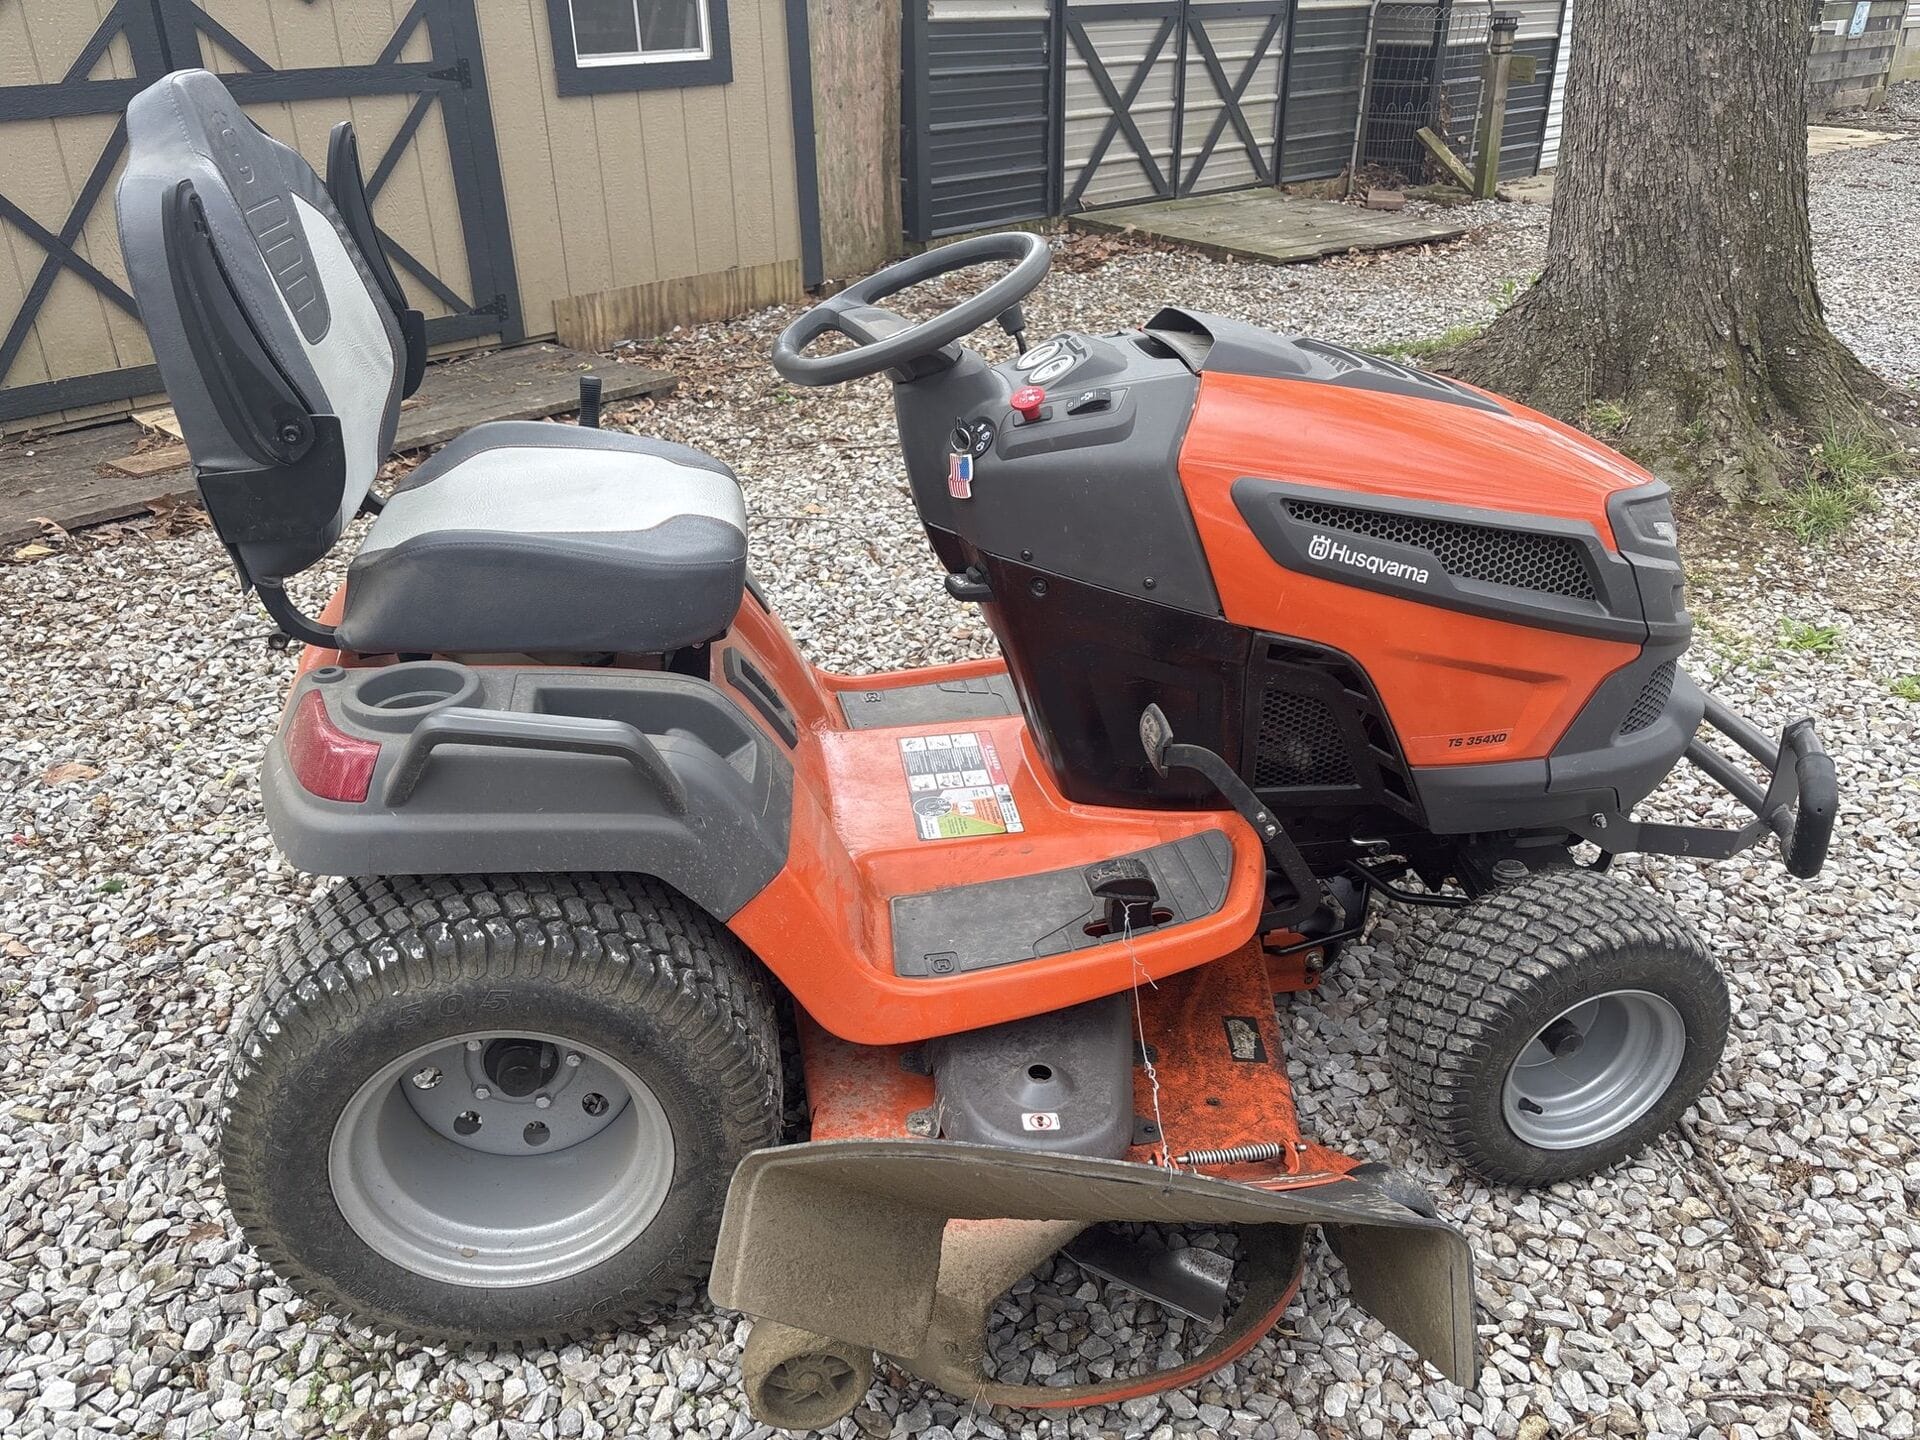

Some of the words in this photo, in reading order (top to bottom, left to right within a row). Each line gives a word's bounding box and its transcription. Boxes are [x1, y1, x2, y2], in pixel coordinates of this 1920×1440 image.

[1329, 542, 1429, 584] Husqvarna
[1448, 738, 1464, 748] TS
[1467, 733, 1507, 746] 354XD
[394, 989, 512, 1029] 505
